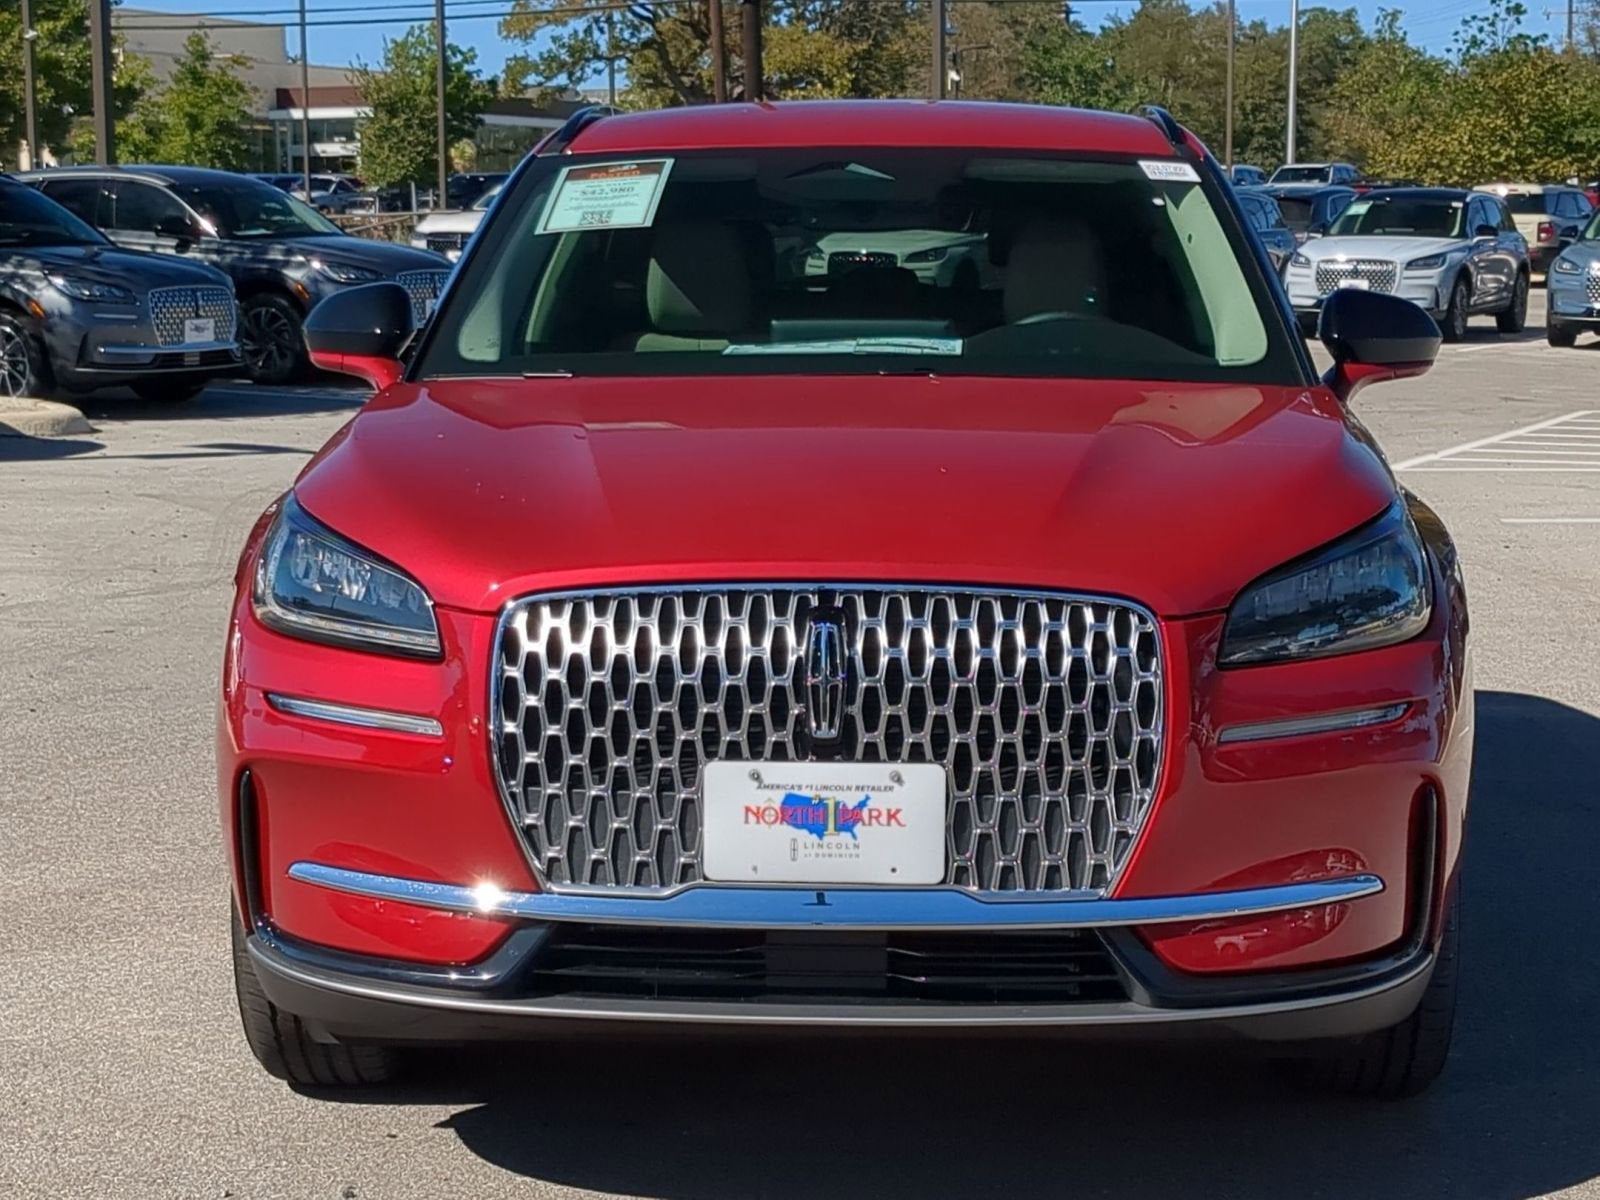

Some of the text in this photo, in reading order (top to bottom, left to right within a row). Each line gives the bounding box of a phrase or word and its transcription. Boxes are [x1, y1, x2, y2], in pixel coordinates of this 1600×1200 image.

[756, 784, 803, 792] AMERICA'S
[815, 784, 852, 792] LINCOLN
[855, 785, 894, 793] RETAILER
[744, 806, 906, 828] NORTH PARK
[804, 842, 860, 850] LINCOLN
